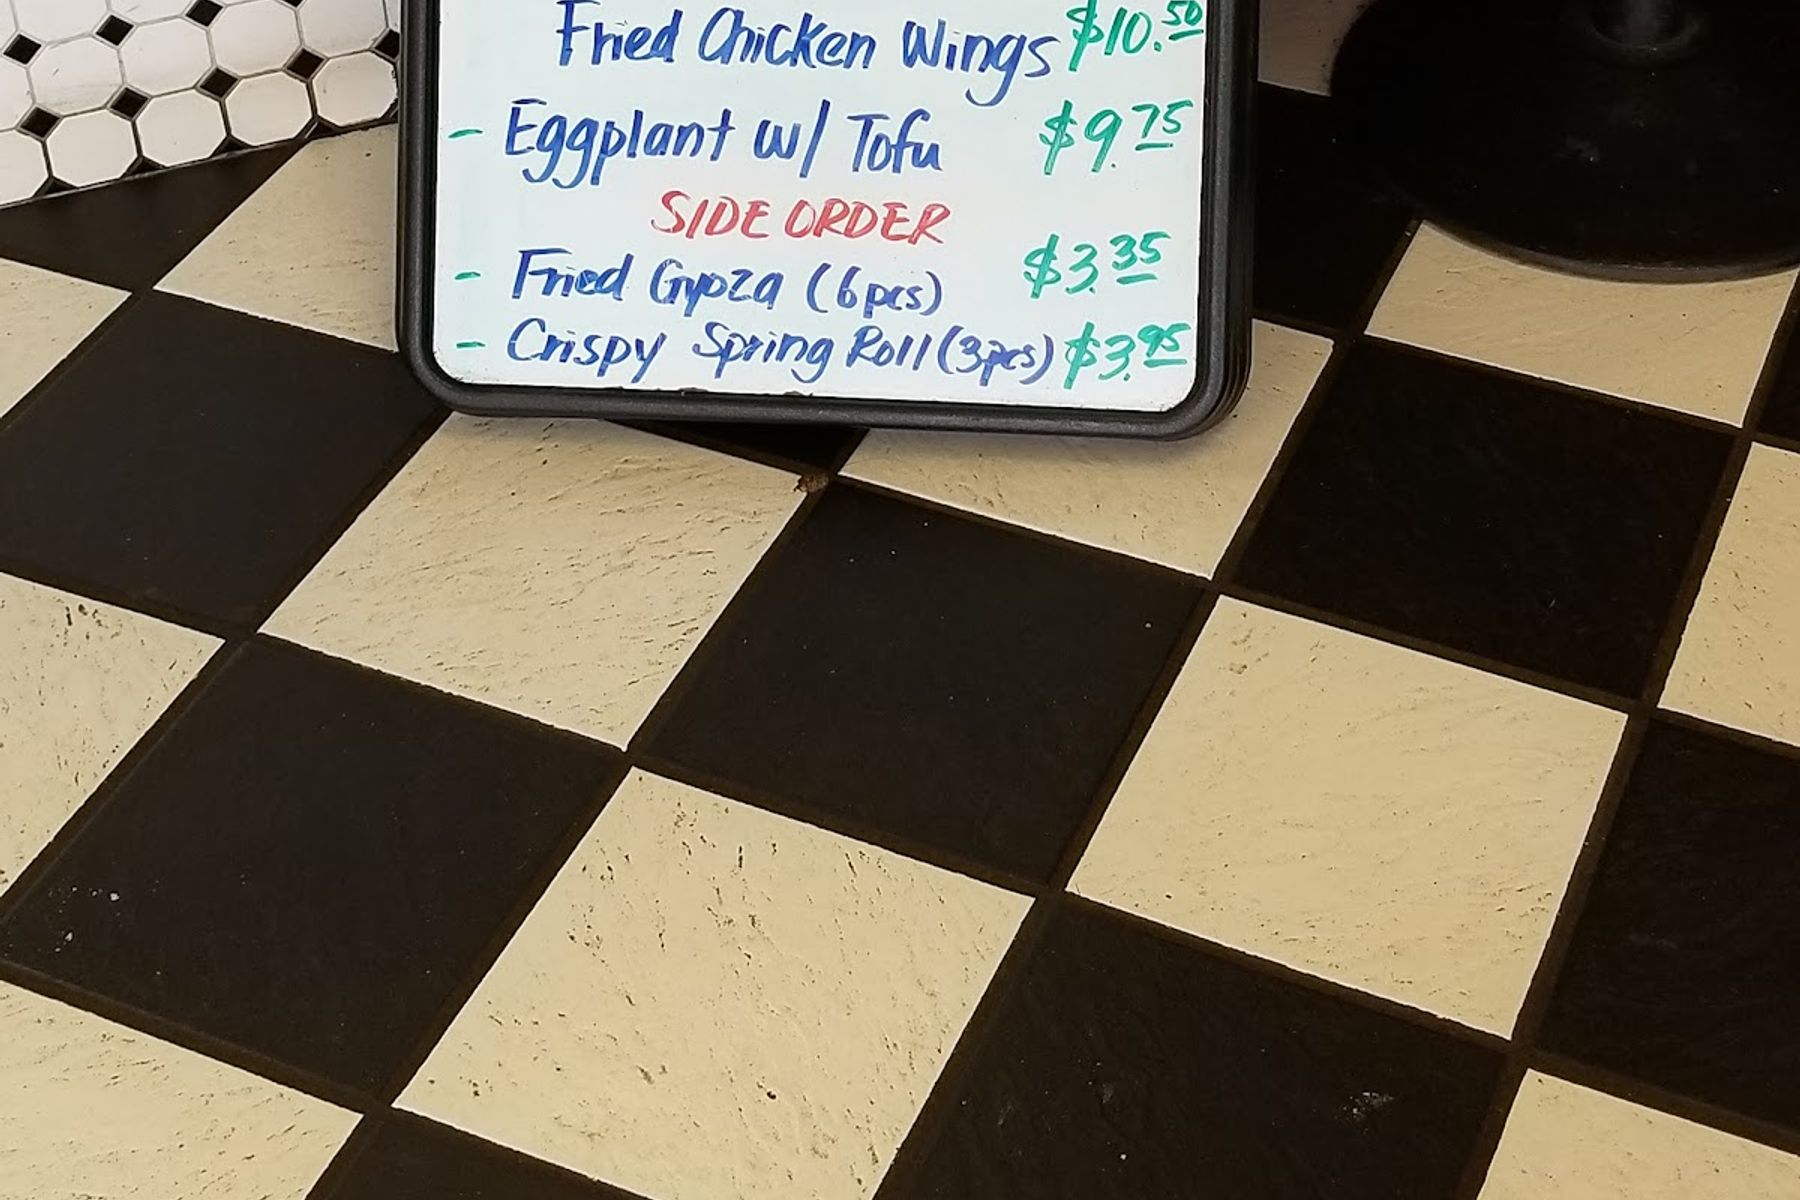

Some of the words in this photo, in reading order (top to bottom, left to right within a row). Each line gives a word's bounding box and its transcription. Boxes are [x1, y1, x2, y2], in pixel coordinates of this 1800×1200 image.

[698, 7, 878, 70] Chicken
[902, 20, 1060, 107] Wings
[505, 98, 733, 189] Eggplant
[753, 99, 830, 178] w/
[848, 108, 944, 176] Tofu
[650, 189, 770, 240] SIDE
[784, 197, 952, 246] ORDER
[511, 248, 634, 303] Fried
[506, 317, 668, 384] Crispy
[691, 321, 834, 384] Spring
